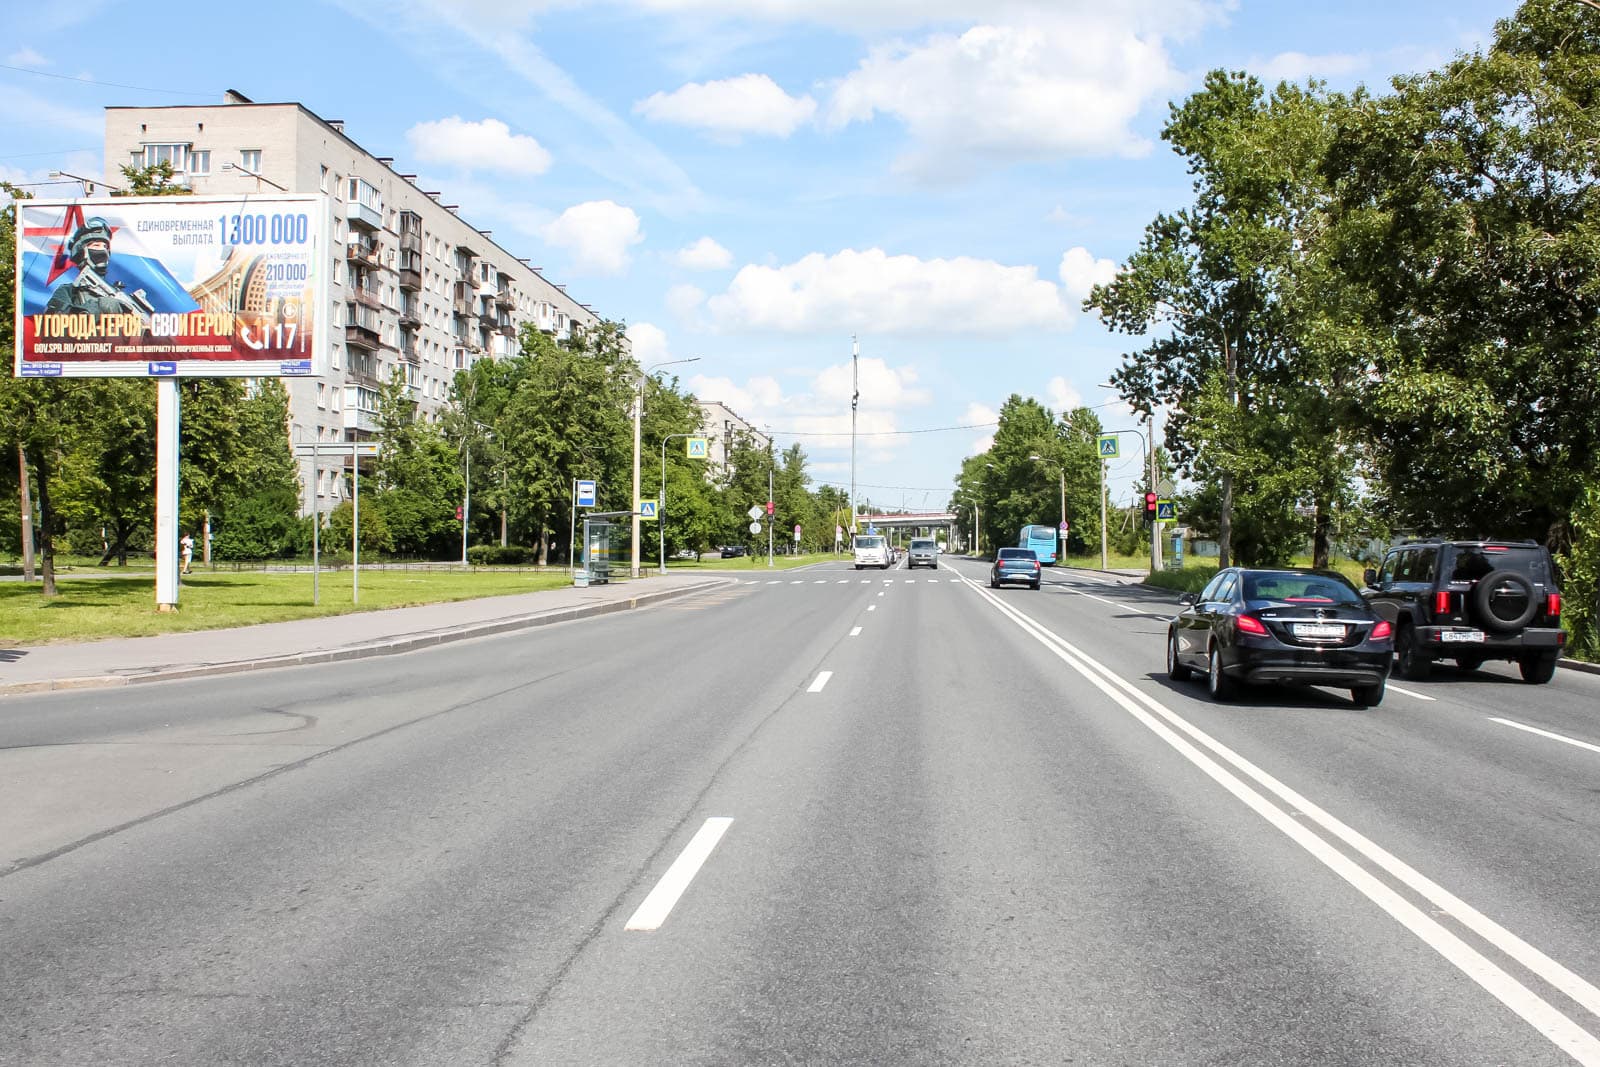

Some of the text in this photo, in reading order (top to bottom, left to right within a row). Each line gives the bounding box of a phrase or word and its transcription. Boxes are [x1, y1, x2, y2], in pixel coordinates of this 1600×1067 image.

[137, 219, 214, 232] ЕДИНОВРЕМЕННАЯ
[271, 213, 308, 245] 000
[172, 234, 214, 246] ВЫПЛАТА
[265, 263, 307, 281] 210 000
[33, 314, 43, 337] У
[44, 313, 141, 340] ГОРОДА-ГЕРОЯ
[151, 313, 188, 337] СВОИ
[262, 322, 297, 349] 117
[34, 342, 113, 353] GOV.SPB.RU/CONTRACT
